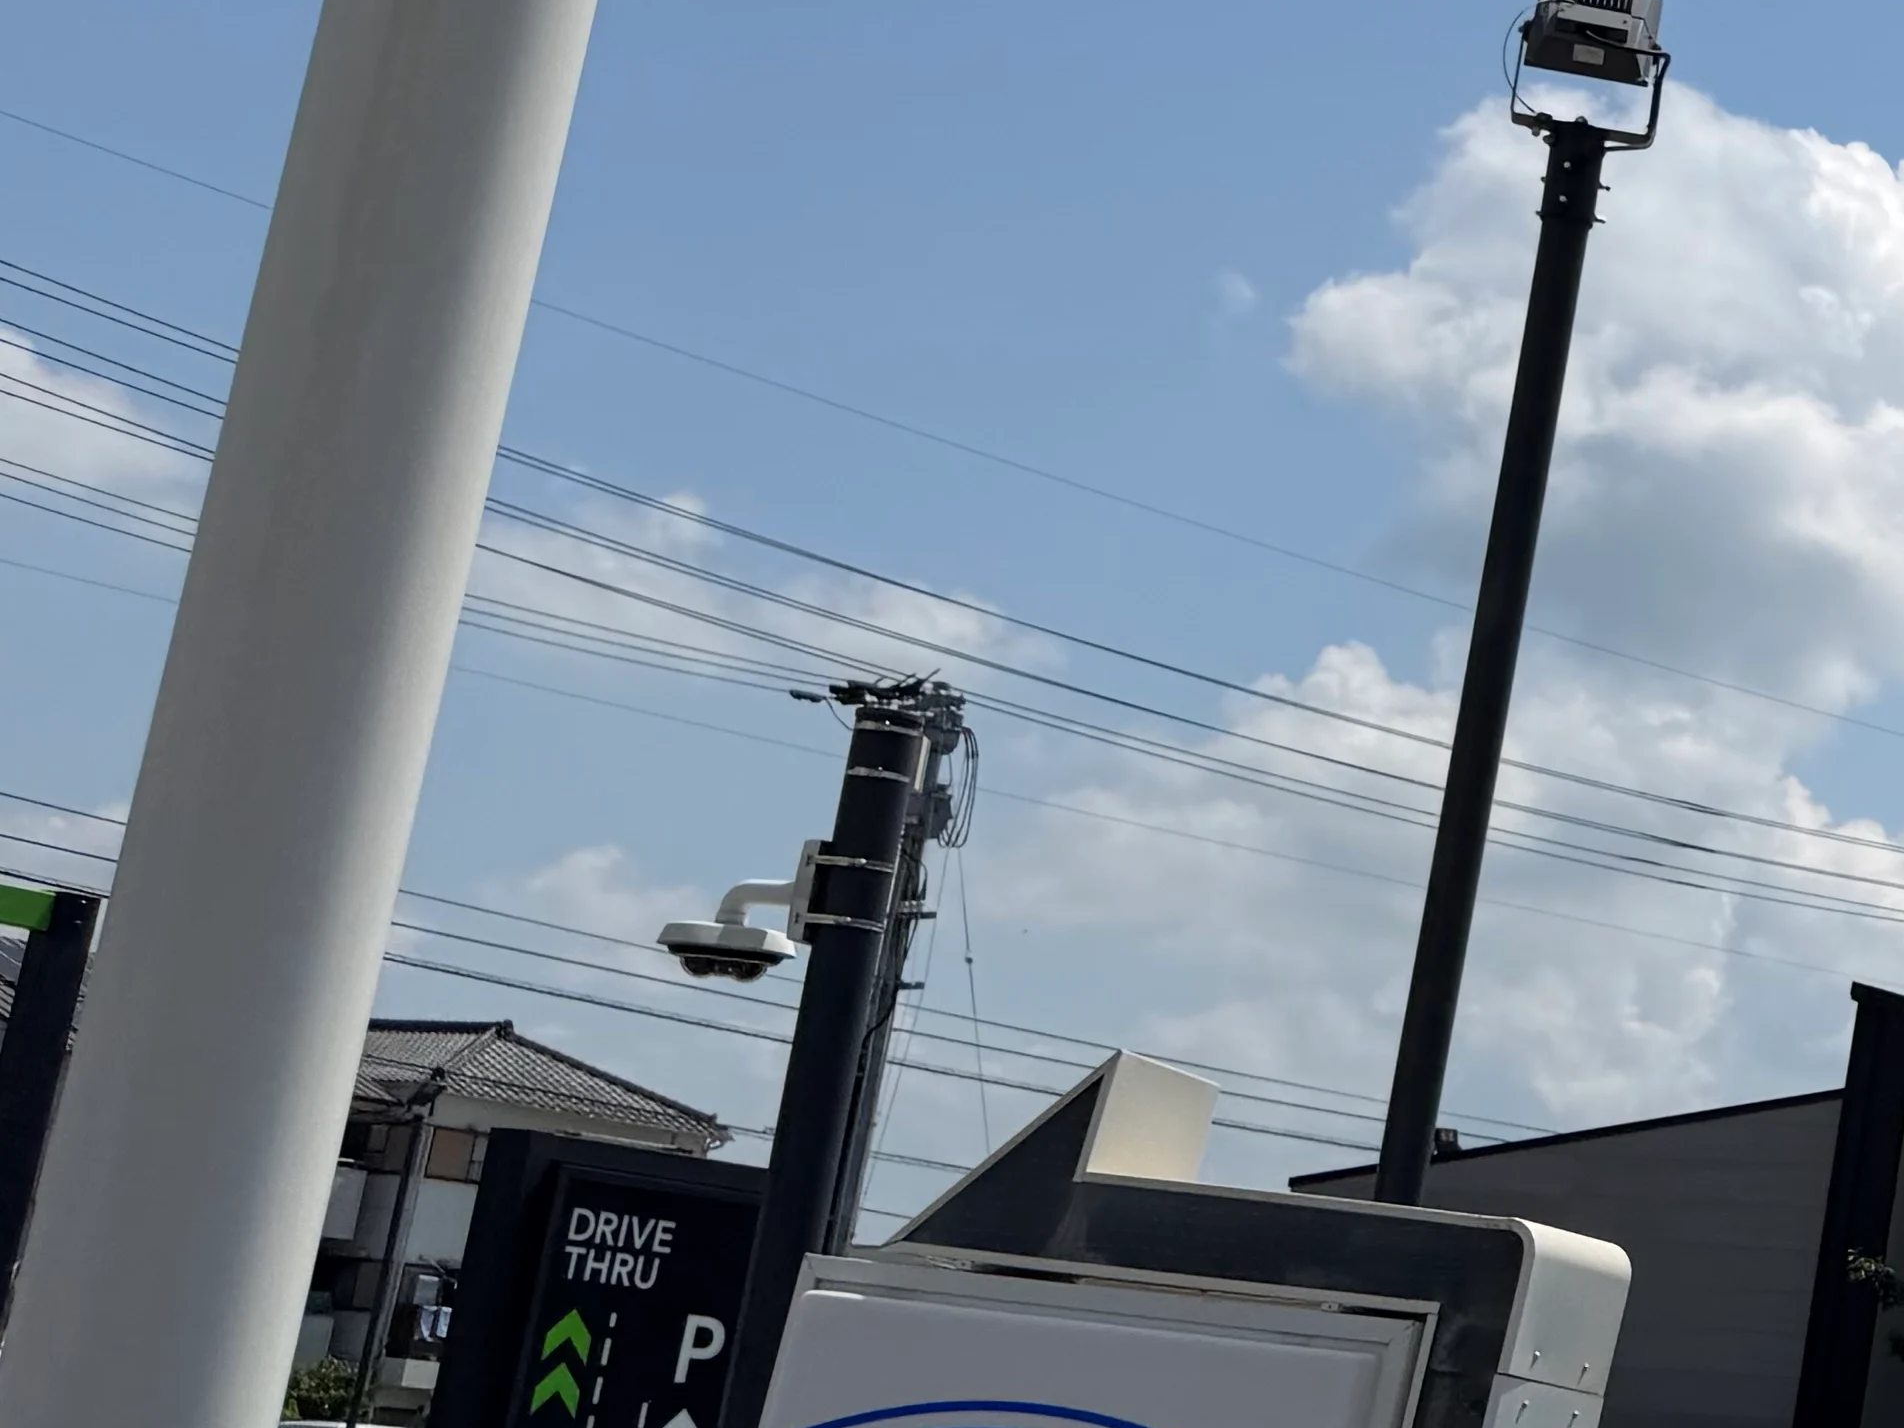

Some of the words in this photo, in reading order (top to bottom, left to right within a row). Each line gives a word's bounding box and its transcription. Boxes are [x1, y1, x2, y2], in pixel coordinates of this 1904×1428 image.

[567, 1206, 677, 1256] DRIVE
[565, 1246, 662, 1291] THRU
[674, 1315, 726, 1384] P
